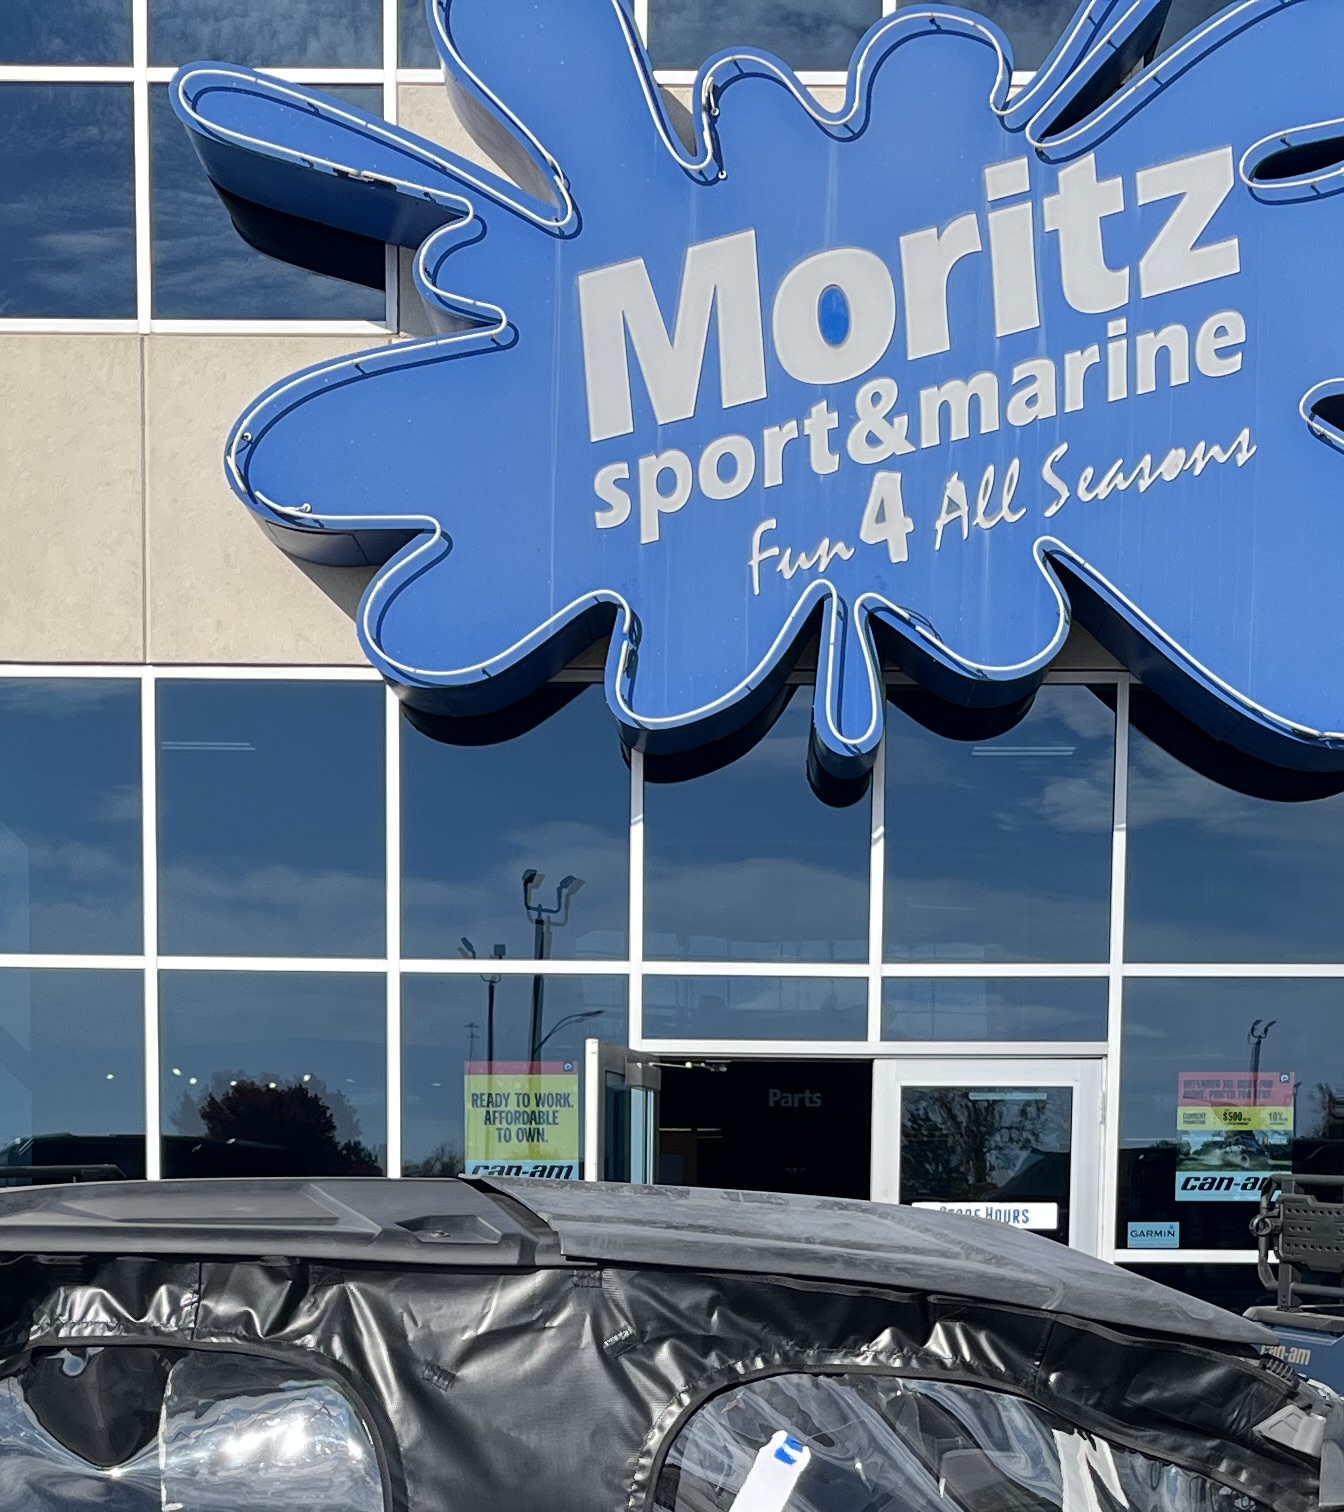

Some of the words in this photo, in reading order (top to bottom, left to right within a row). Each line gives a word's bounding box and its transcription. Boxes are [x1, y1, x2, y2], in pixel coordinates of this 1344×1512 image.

[577, 145, 1241, 443] Moritz
[594, 310, 1247, 545] sport&marine
[748, 518, 855, 596] Fun
[859, 471, 914, 563] 4
[934, 458, 1026, 550] All
[1042, 427, 1257, 518] Seasons
[471, 1093, 510, 1108] READY
[515, 1093, 530, 1108] TO
[535, 1093, 574, 1108] WORK.
[768, 1088, 822, 1107] Parts
[484, 1110, 560, 1125] AFFORDABLE
[1223, 1111, 1243, 1122] $500
[496, 1127, 512, 1143] TO
[516, 1127, 548, 1143] OWN.
[1180, 1176, 1269, 1191] can-a
[1130, 1230, 1176, 1238] GARMIN
